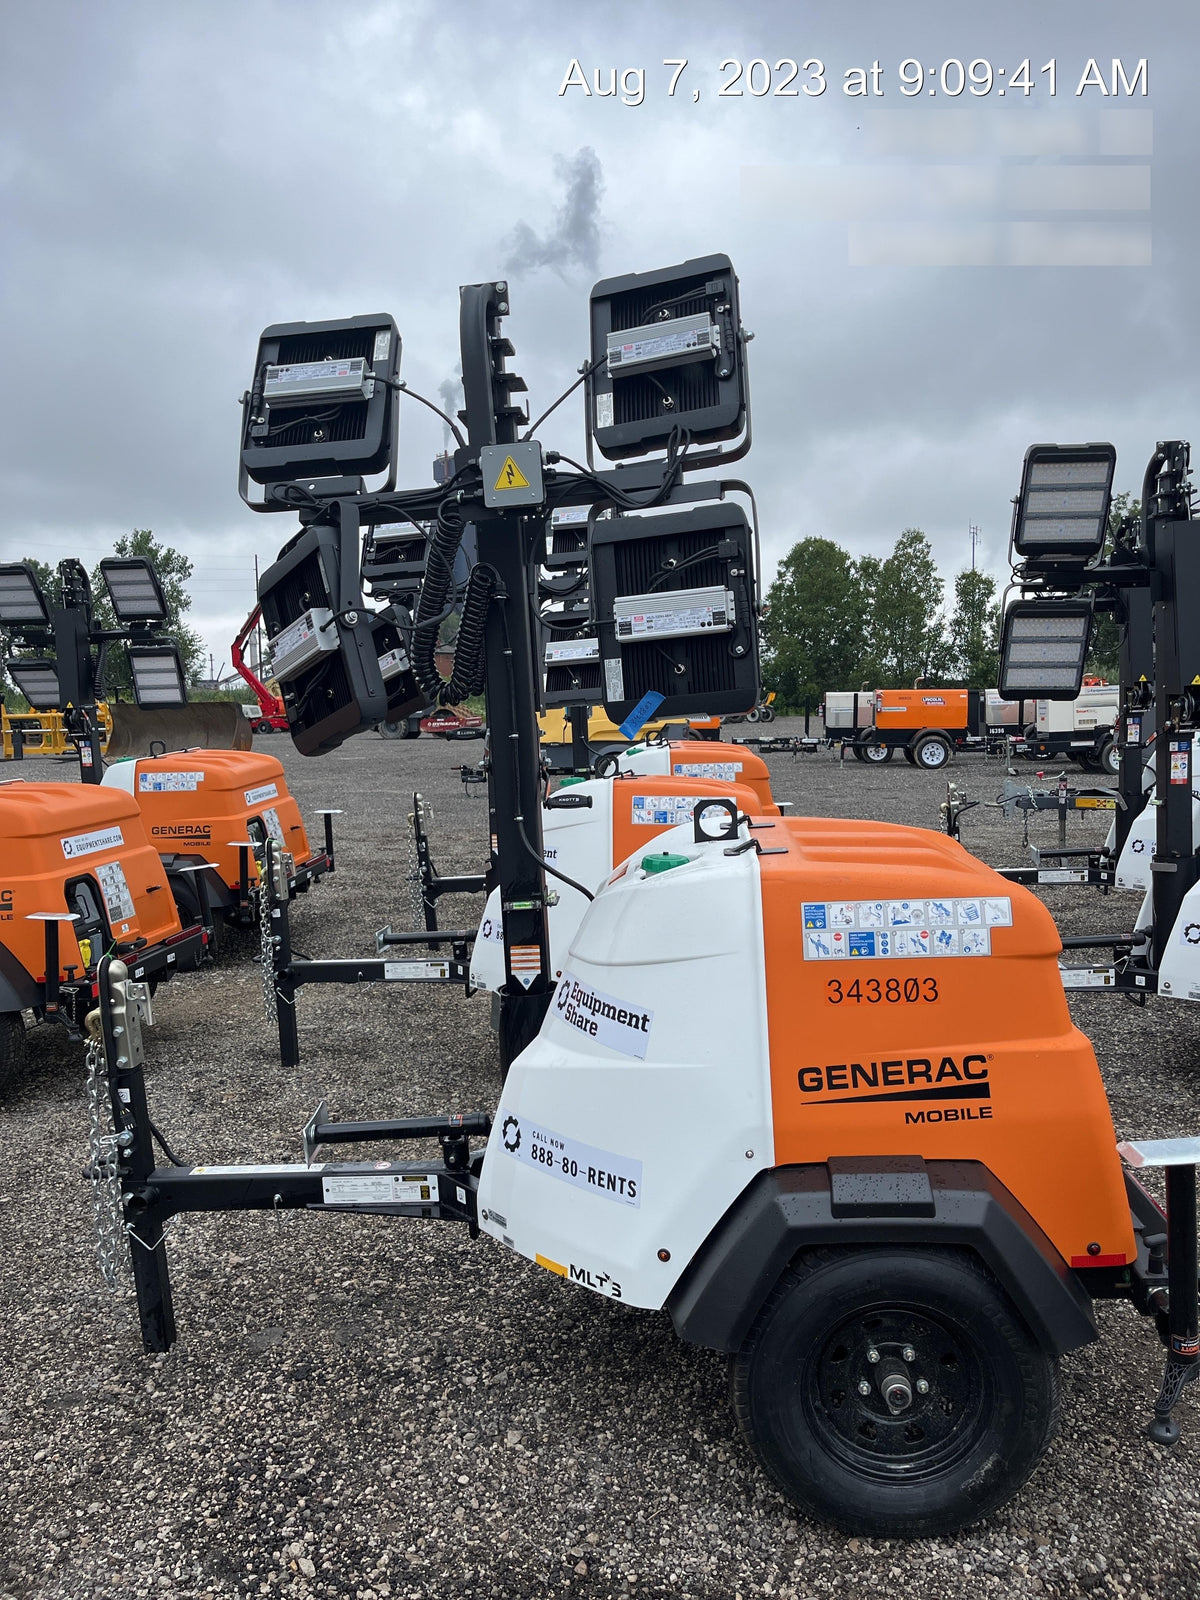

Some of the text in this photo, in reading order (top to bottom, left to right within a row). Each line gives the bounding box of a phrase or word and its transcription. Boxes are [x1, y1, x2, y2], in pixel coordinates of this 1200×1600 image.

[151, 825, 211, 835] GENERAC
[827, 977, 939, 1004] 343803
[564, 1003, 598, 1037] Share
[571, 981, 650, 1033] Equipment
[798, 1055, 989, 1092] GENERAC
[904, 1106, 993, 1125] MOBILE
[532, 1130, 565, 1151] CALL NOW
[531, 1143, 638, 1198] 888-80-RENTS
